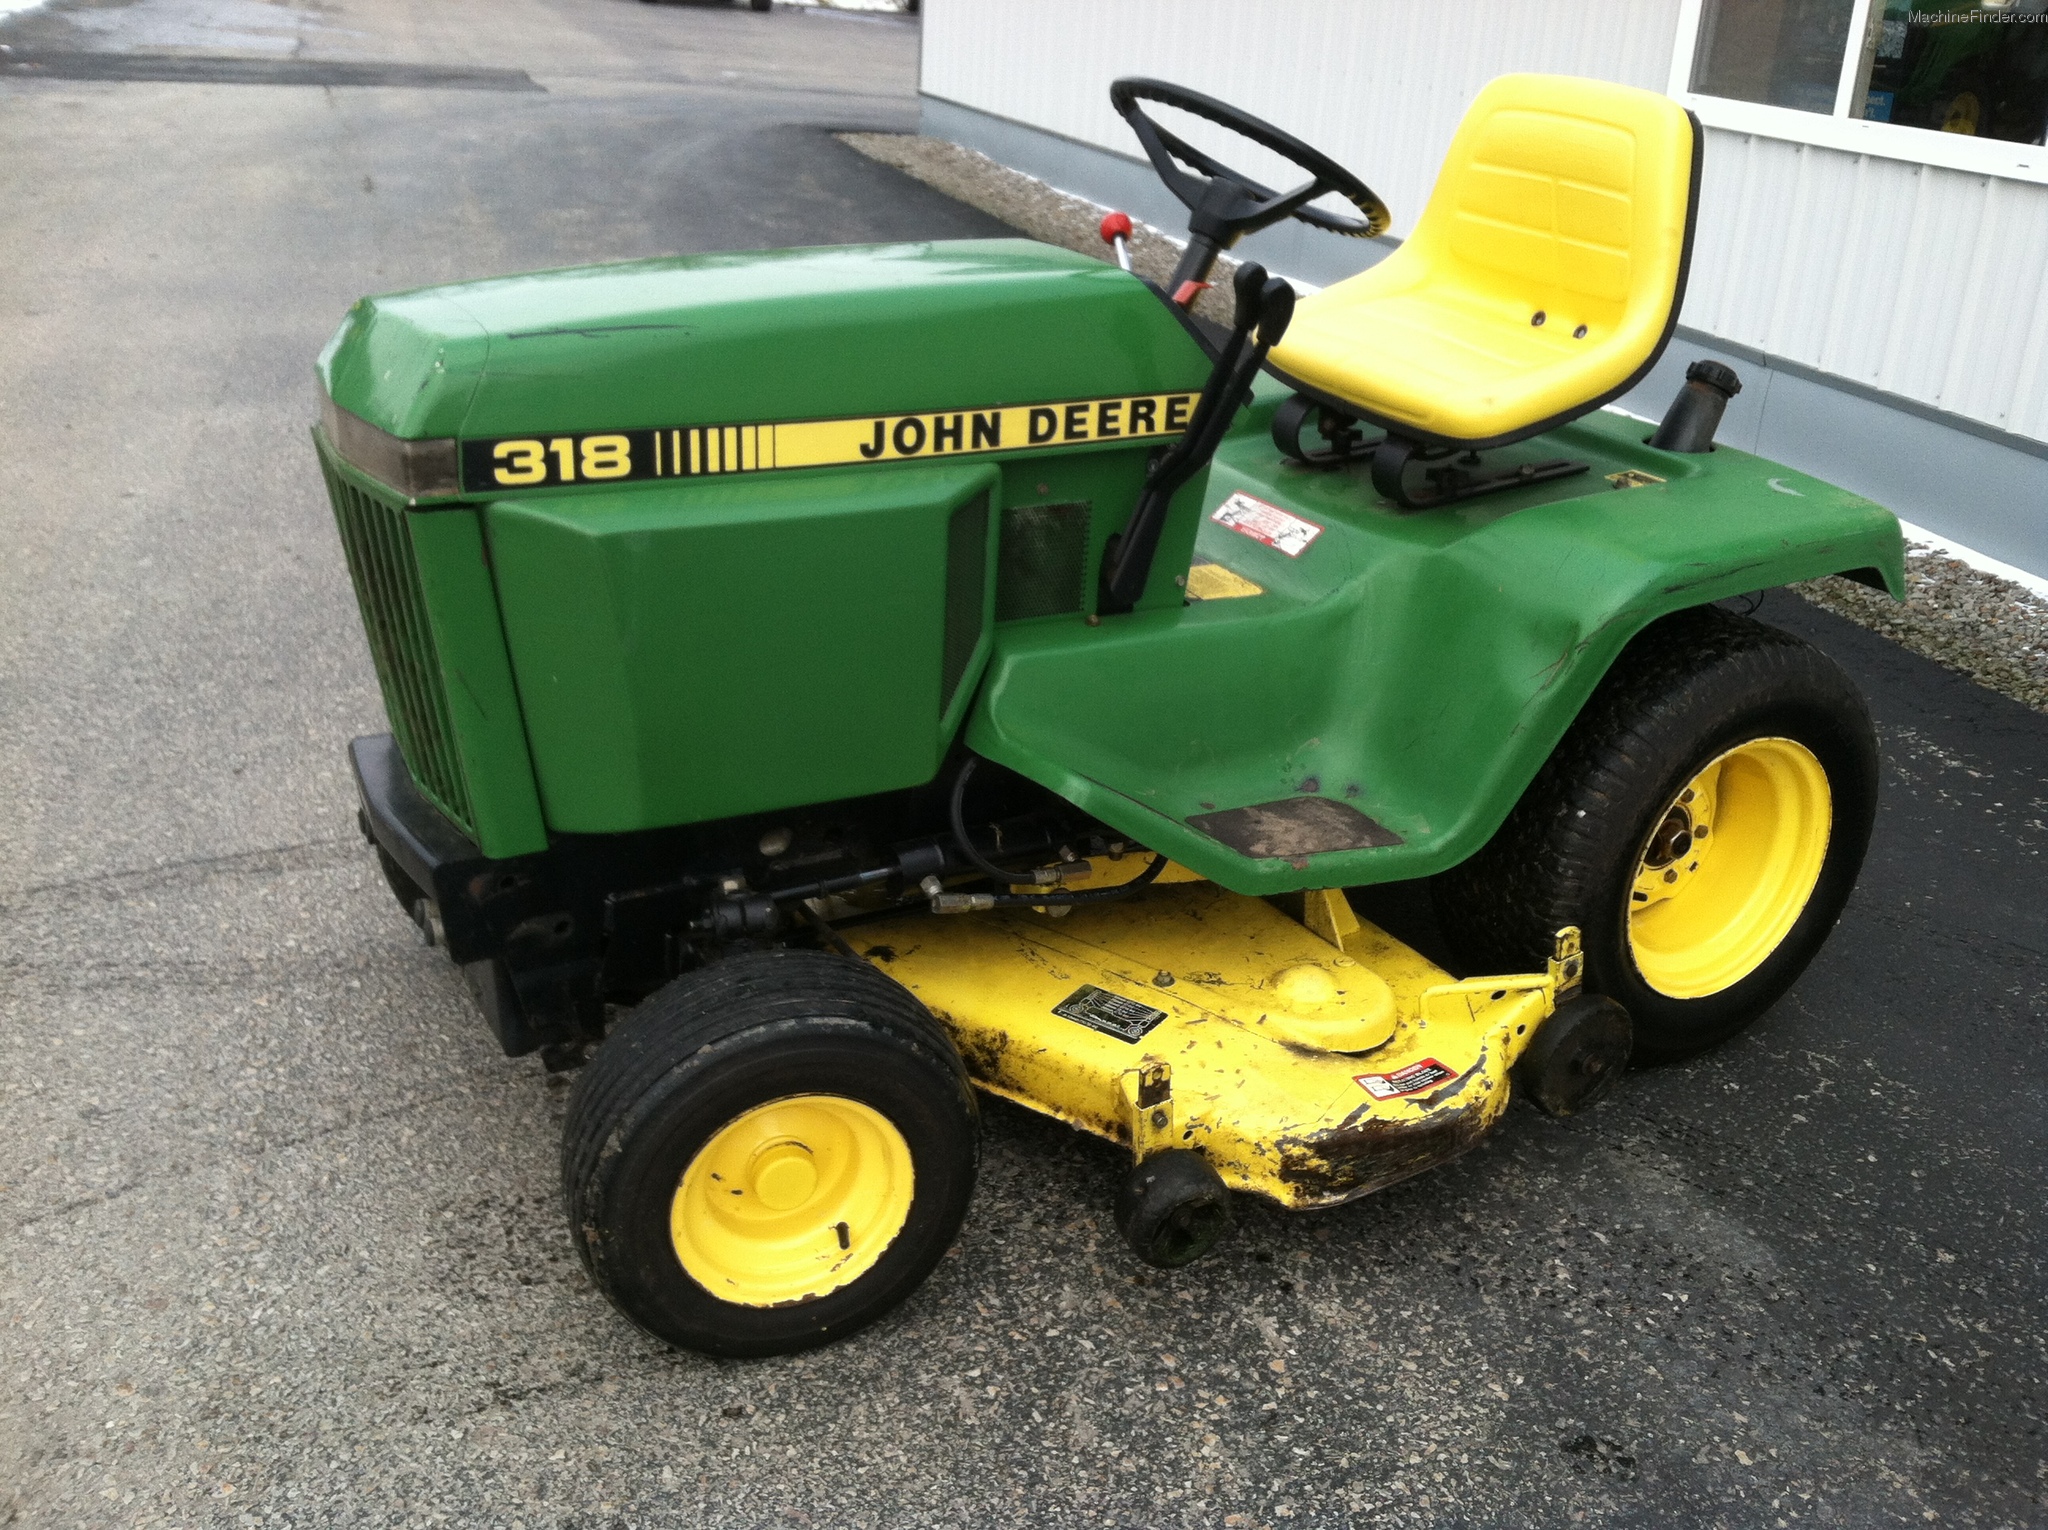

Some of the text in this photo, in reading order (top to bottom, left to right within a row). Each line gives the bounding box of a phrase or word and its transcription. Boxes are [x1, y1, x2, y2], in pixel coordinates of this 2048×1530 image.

[493, 395, 1191, 485] 318 JOHN DEERE
